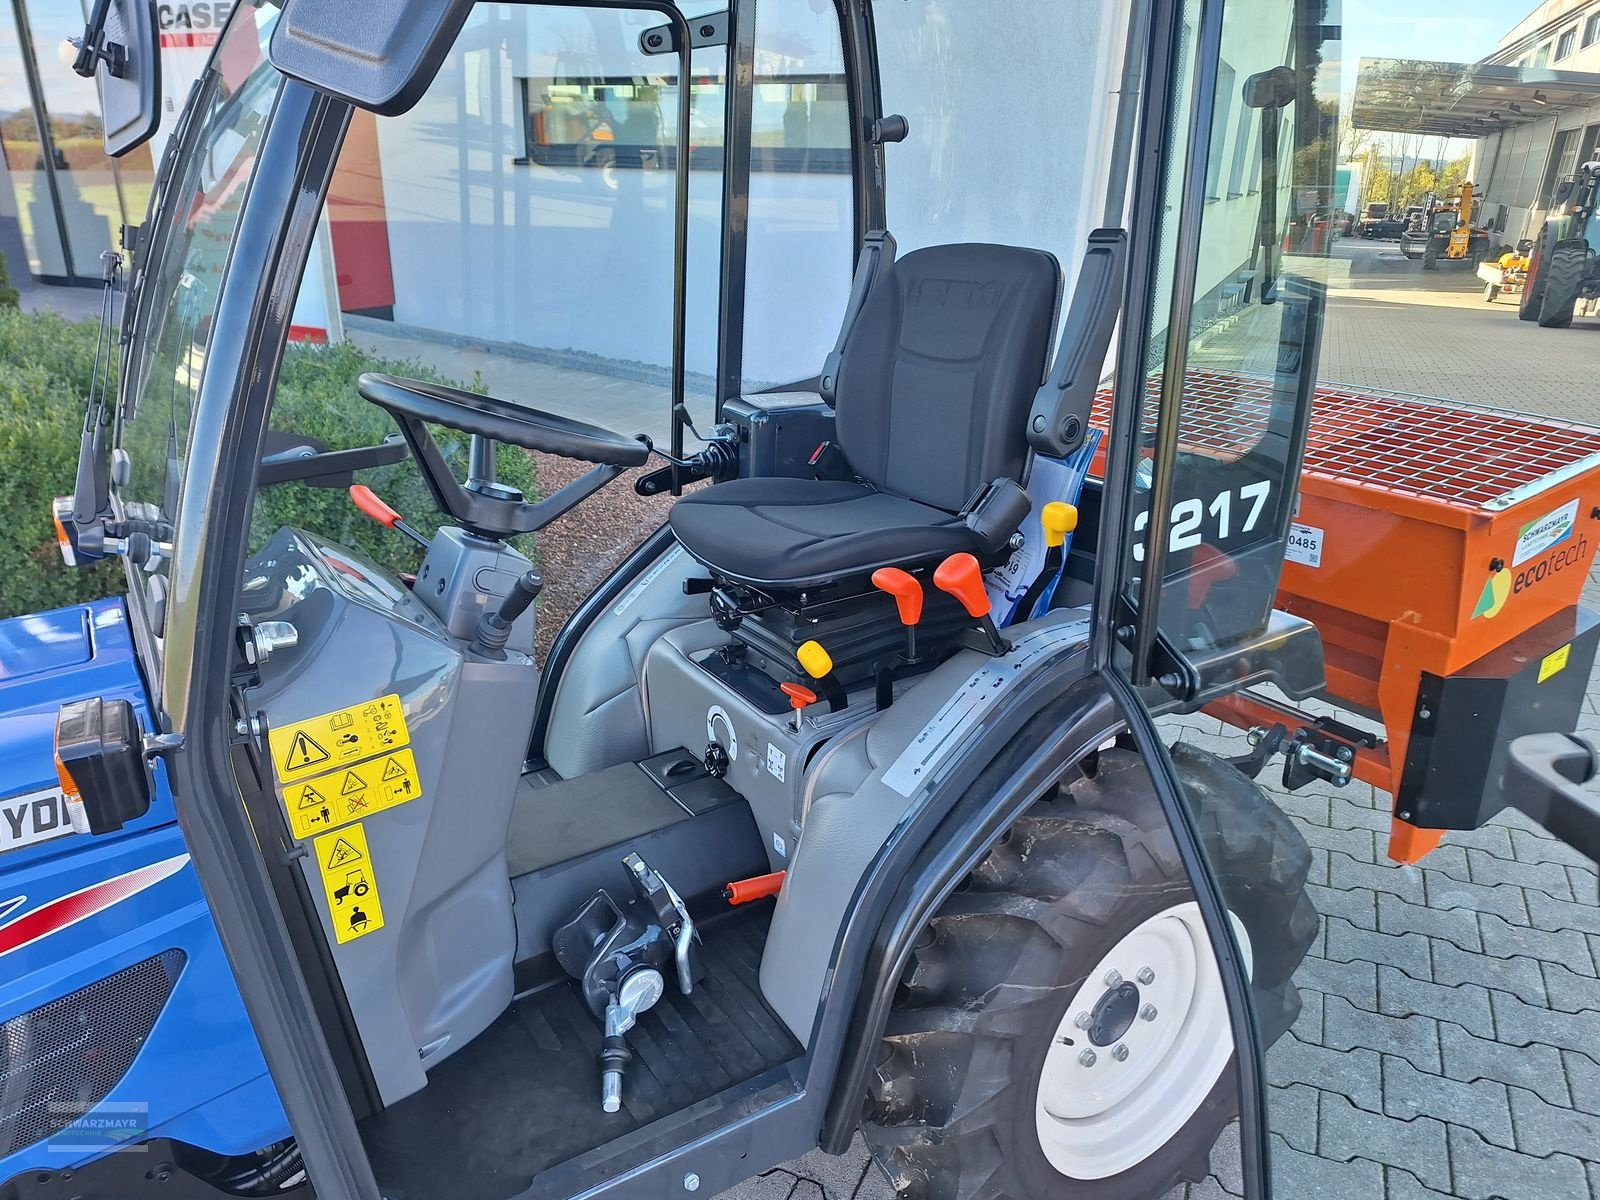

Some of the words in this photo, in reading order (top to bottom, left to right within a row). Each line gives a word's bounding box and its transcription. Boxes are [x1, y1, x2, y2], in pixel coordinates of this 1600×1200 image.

[159, 2, 231, 30] CASE
[1289, 535, 1317, 550] 0485
[1522, 513, 1569, 543] SCHWARZMAYR
[1513, 533, 1587, 594] ecotech
